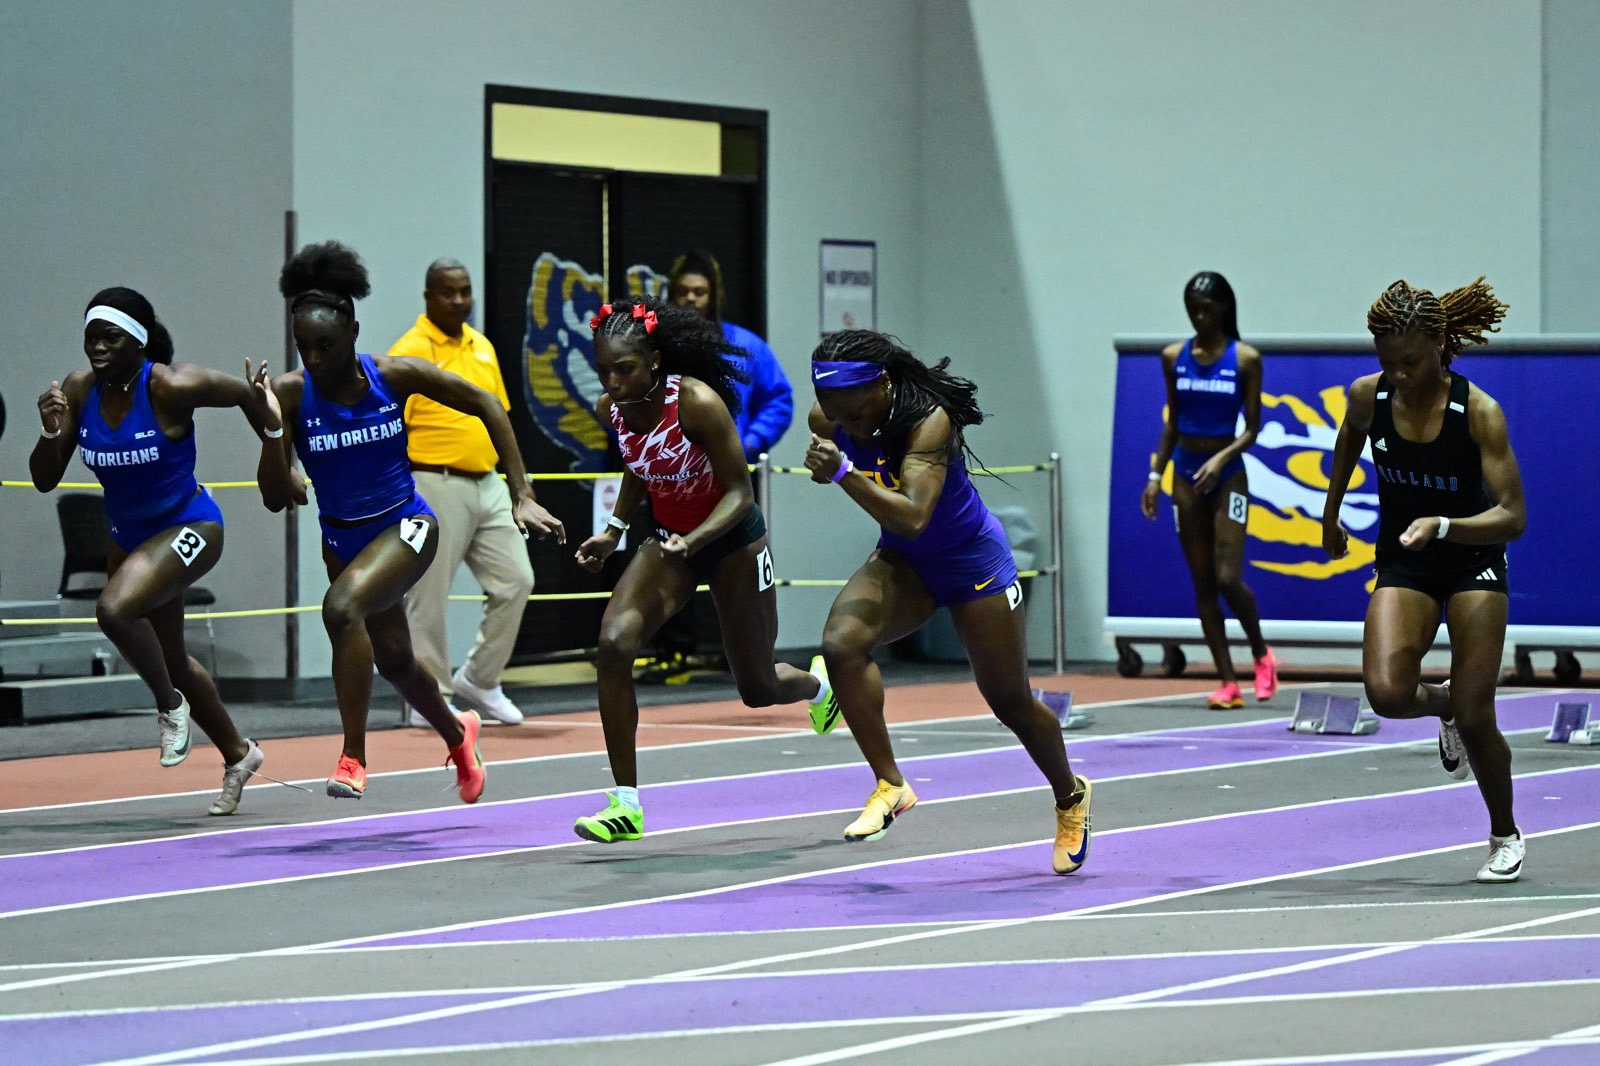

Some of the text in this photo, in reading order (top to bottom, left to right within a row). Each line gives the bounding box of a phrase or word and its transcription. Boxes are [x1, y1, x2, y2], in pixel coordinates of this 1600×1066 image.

[134, 429, 156, 440] SLC
[308, 418, 403, 452] NEW ORLEANS
[97, 446, 160, 467] ORLEANS
[1231, 496, 1243, 518] 8
[762, 550, 772, 586] 6
